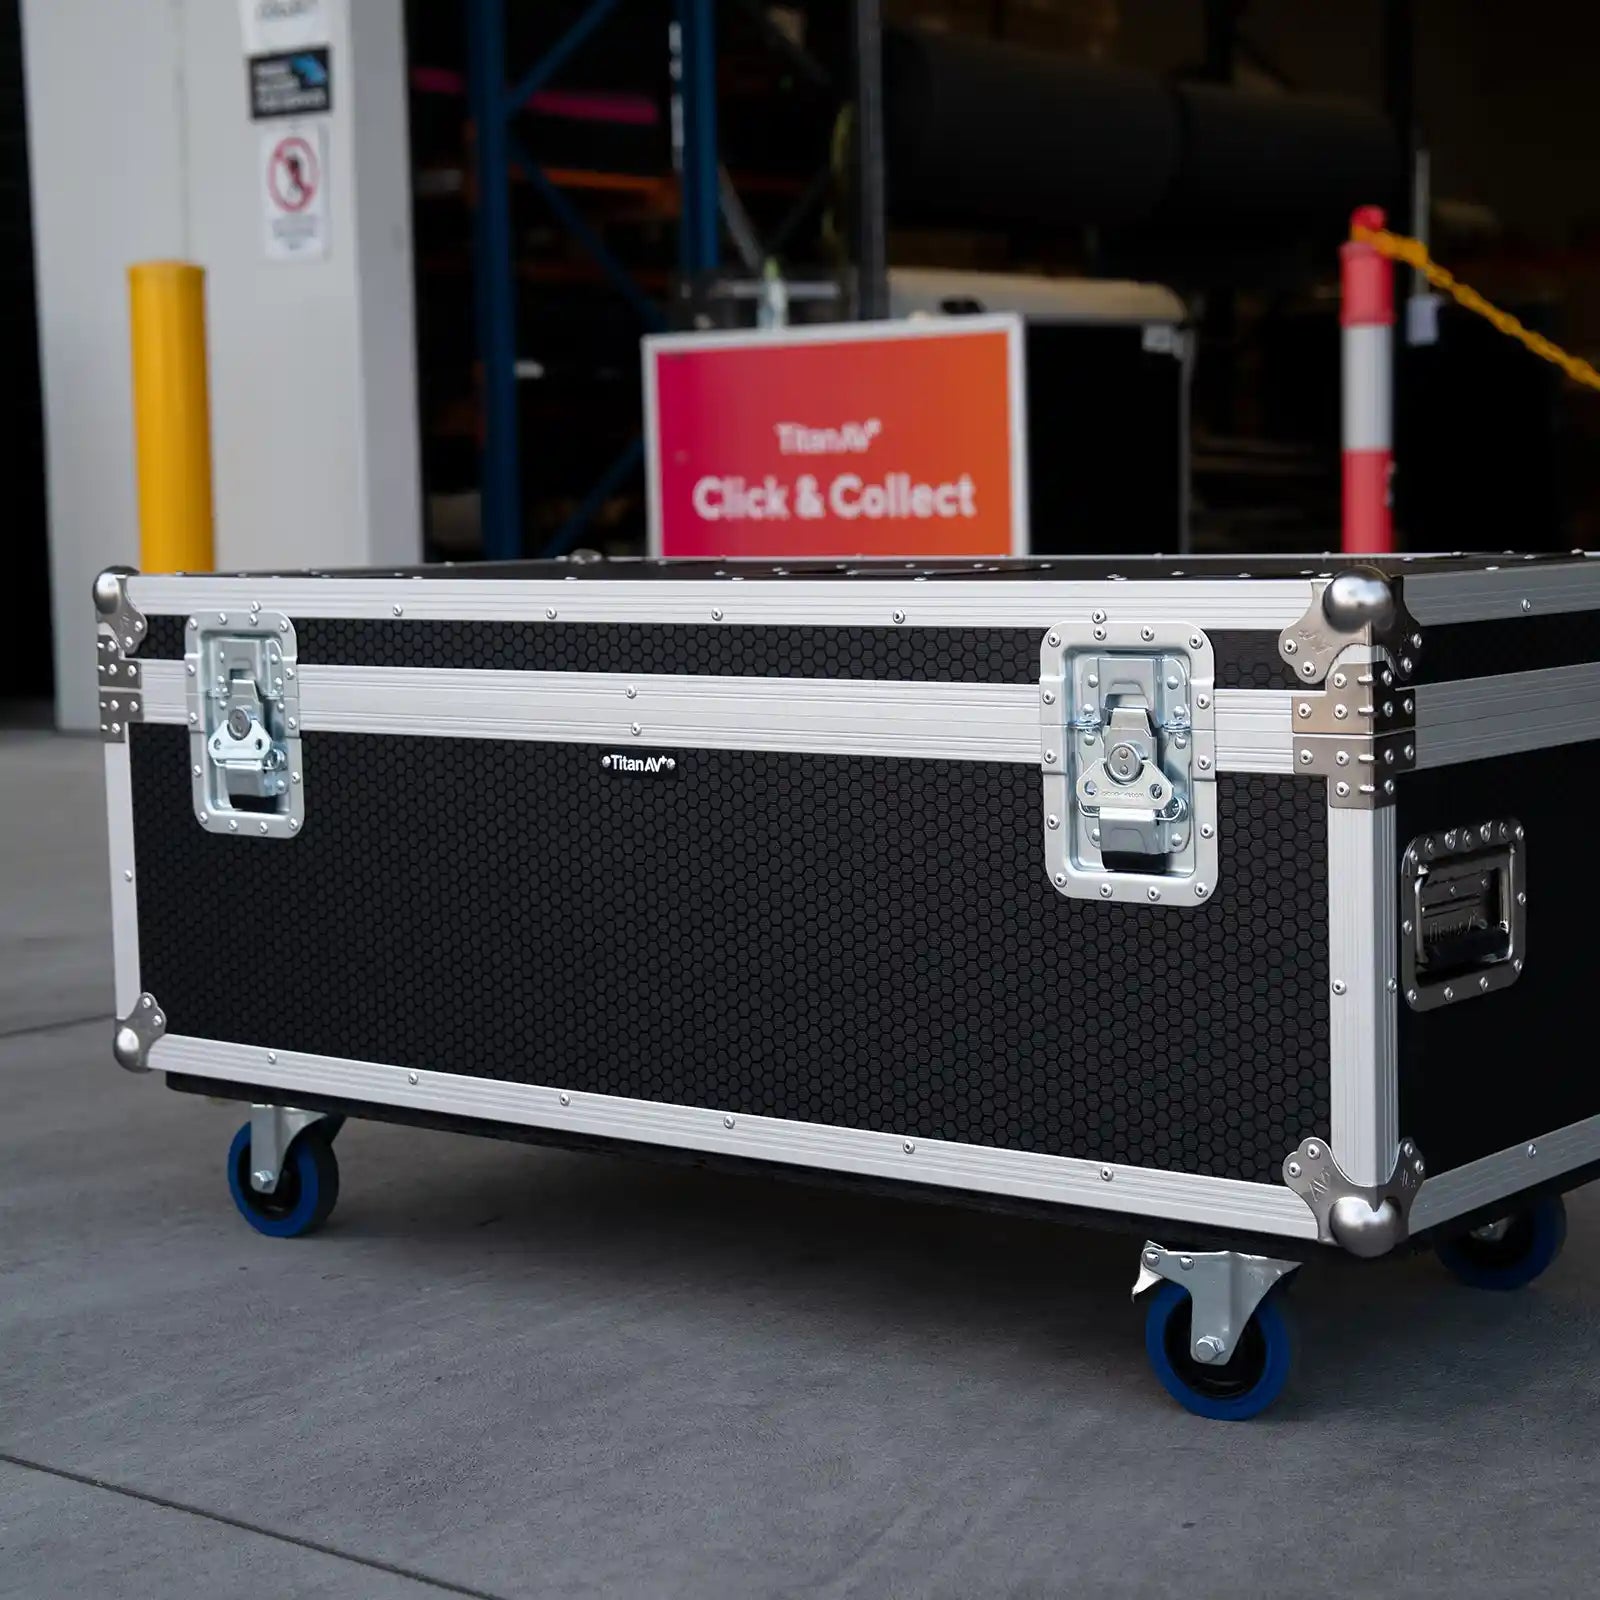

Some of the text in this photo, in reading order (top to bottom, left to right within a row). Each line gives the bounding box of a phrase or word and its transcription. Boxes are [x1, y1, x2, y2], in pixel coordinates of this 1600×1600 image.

[693, 471, 977, 520] Click & Collect
